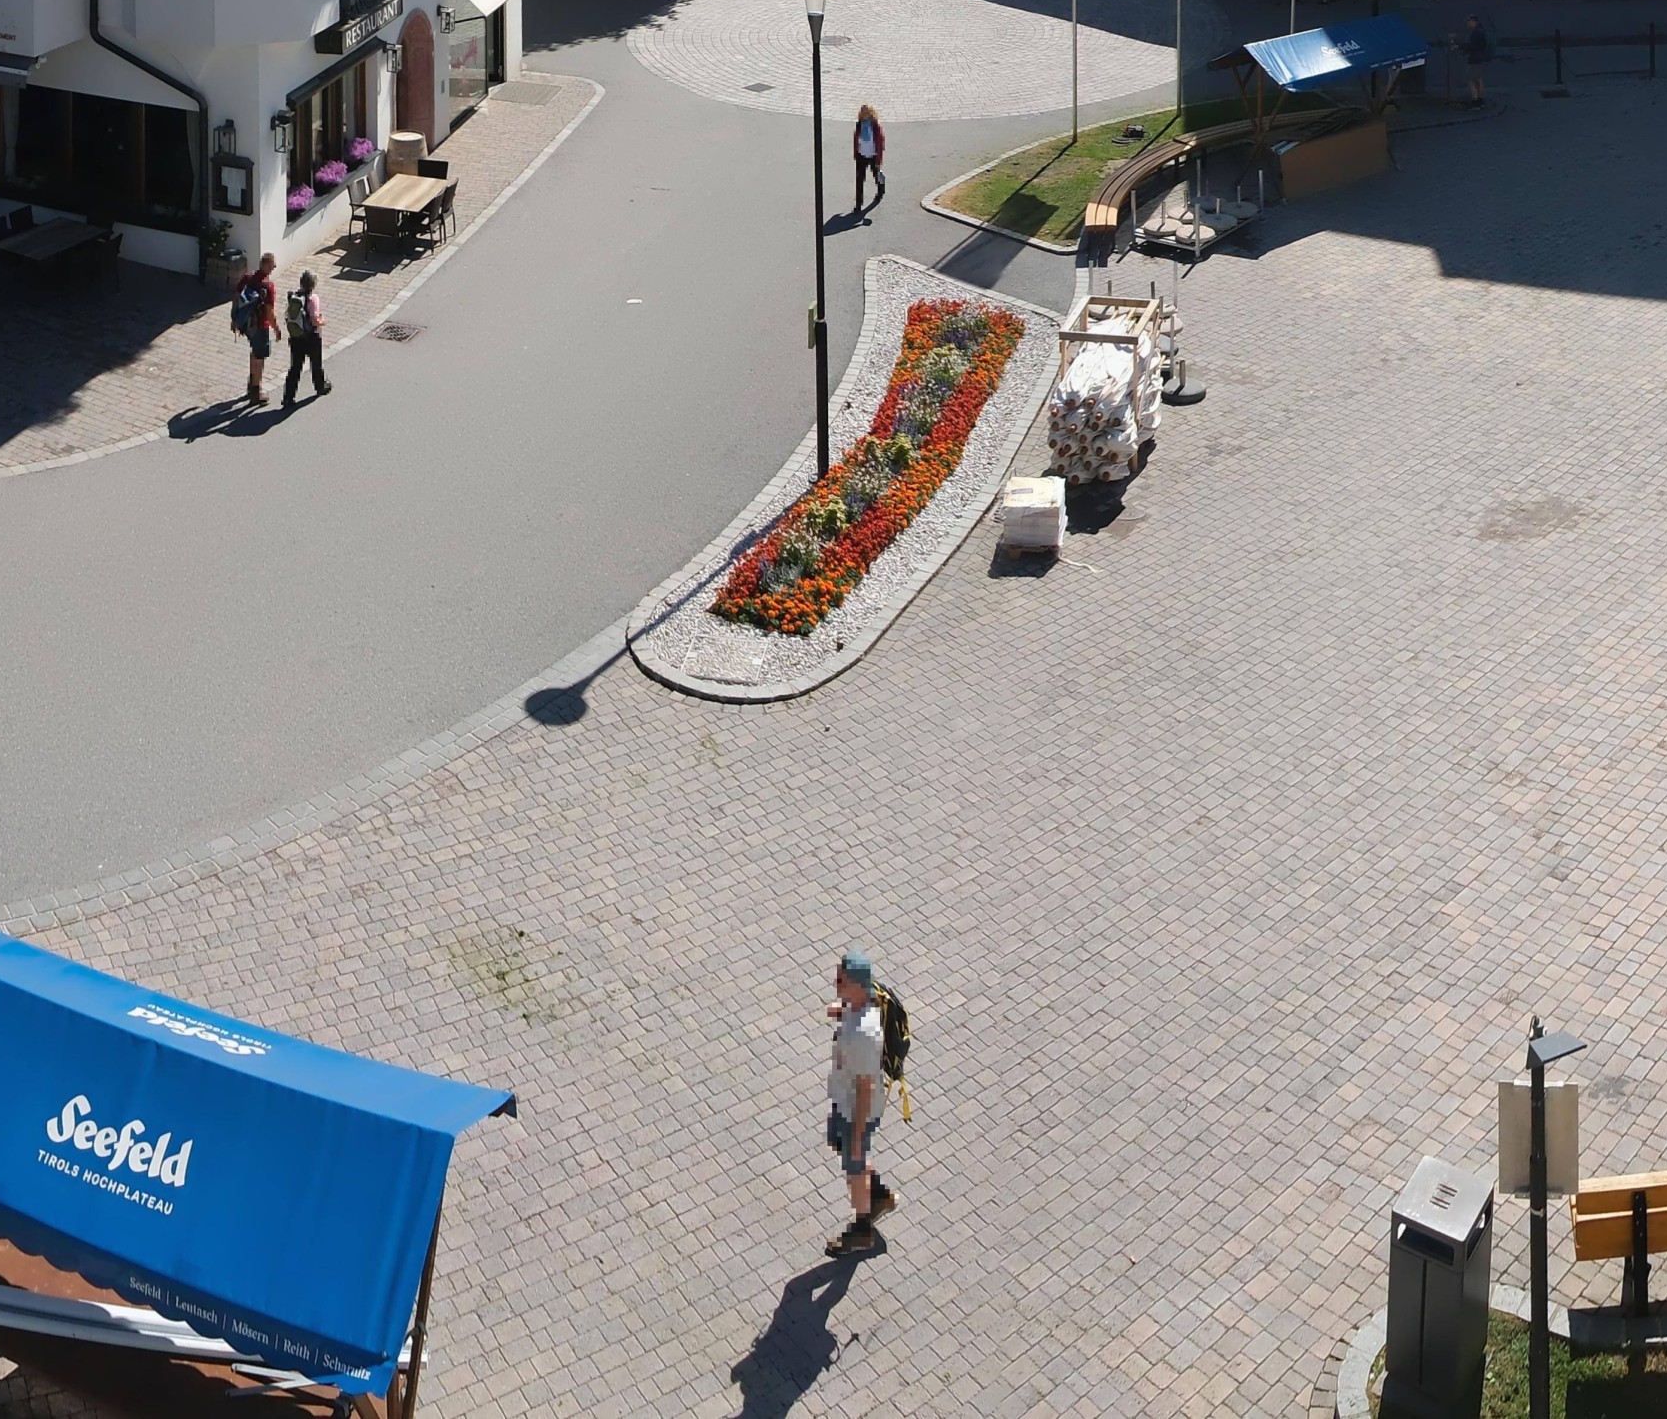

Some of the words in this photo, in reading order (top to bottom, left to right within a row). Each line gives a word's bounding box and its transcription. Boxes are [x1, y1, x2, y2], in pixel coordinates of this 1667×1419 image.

[1320, 39, 1361, 58] Seefeld
[126, 1005, 267, 1056] Seefeld
[46, 1094, 194, 1188] Seefeld
[36, 1148, 80, 1178] TIROLS
[82, 1168, 175, 1216] HOCHPLATEAU
[128, 1275, 162, 1301] Seefeld
[174, 1295, 219, 1325] Leutasch
[230, 1318, 270, 1345] Mösern
[283, 1338, 311, 1361] Reith
[321, 1353, 372, 1381] Scharnitz
